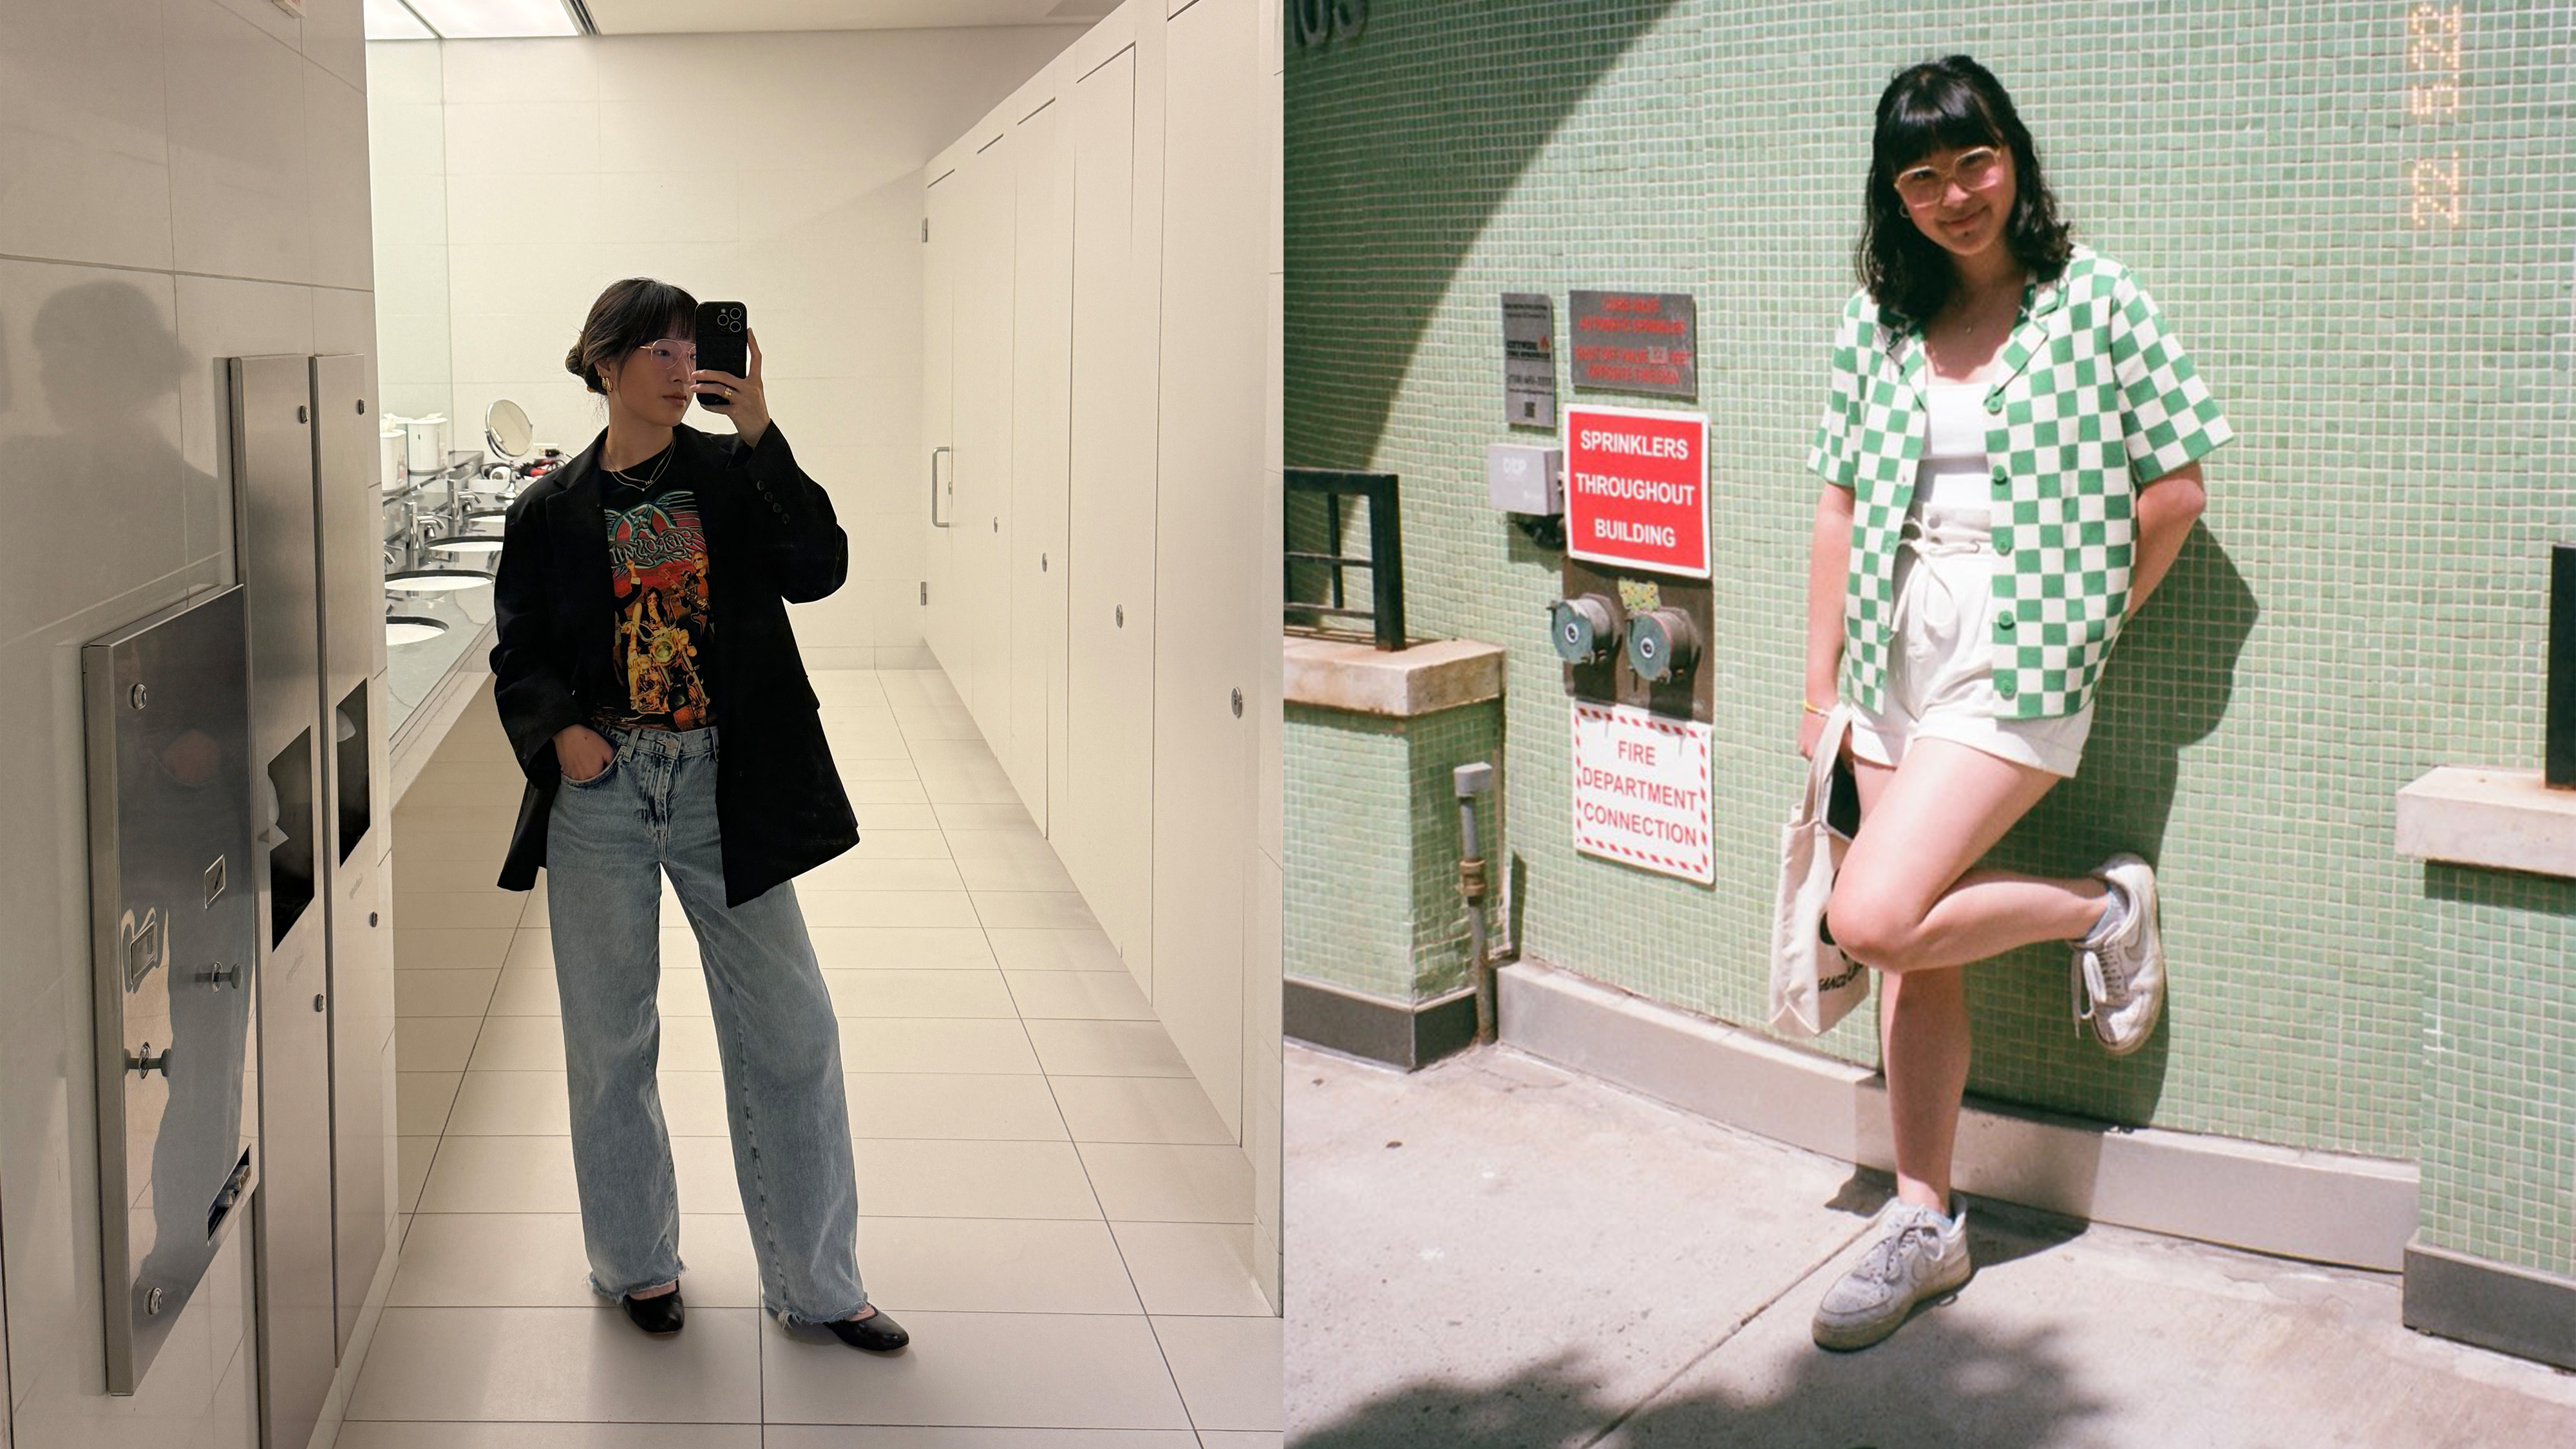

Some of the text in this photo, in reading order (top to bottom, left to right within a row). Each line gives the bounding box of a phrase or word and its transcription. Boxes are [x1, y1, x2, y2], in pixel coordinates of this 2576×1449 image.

[1580, 430, 1689, 460] SPRINKLERS
[1575, 472, 1695, 506] THROUGHOUT
[1595, 518, 1676, 547] BUILDING
[1618, 740, 1656, 767] FIRE
[1582, 766, 1698, 811] DEPARTMENT
[1584, 802, 1697, 847] CONNECTION
